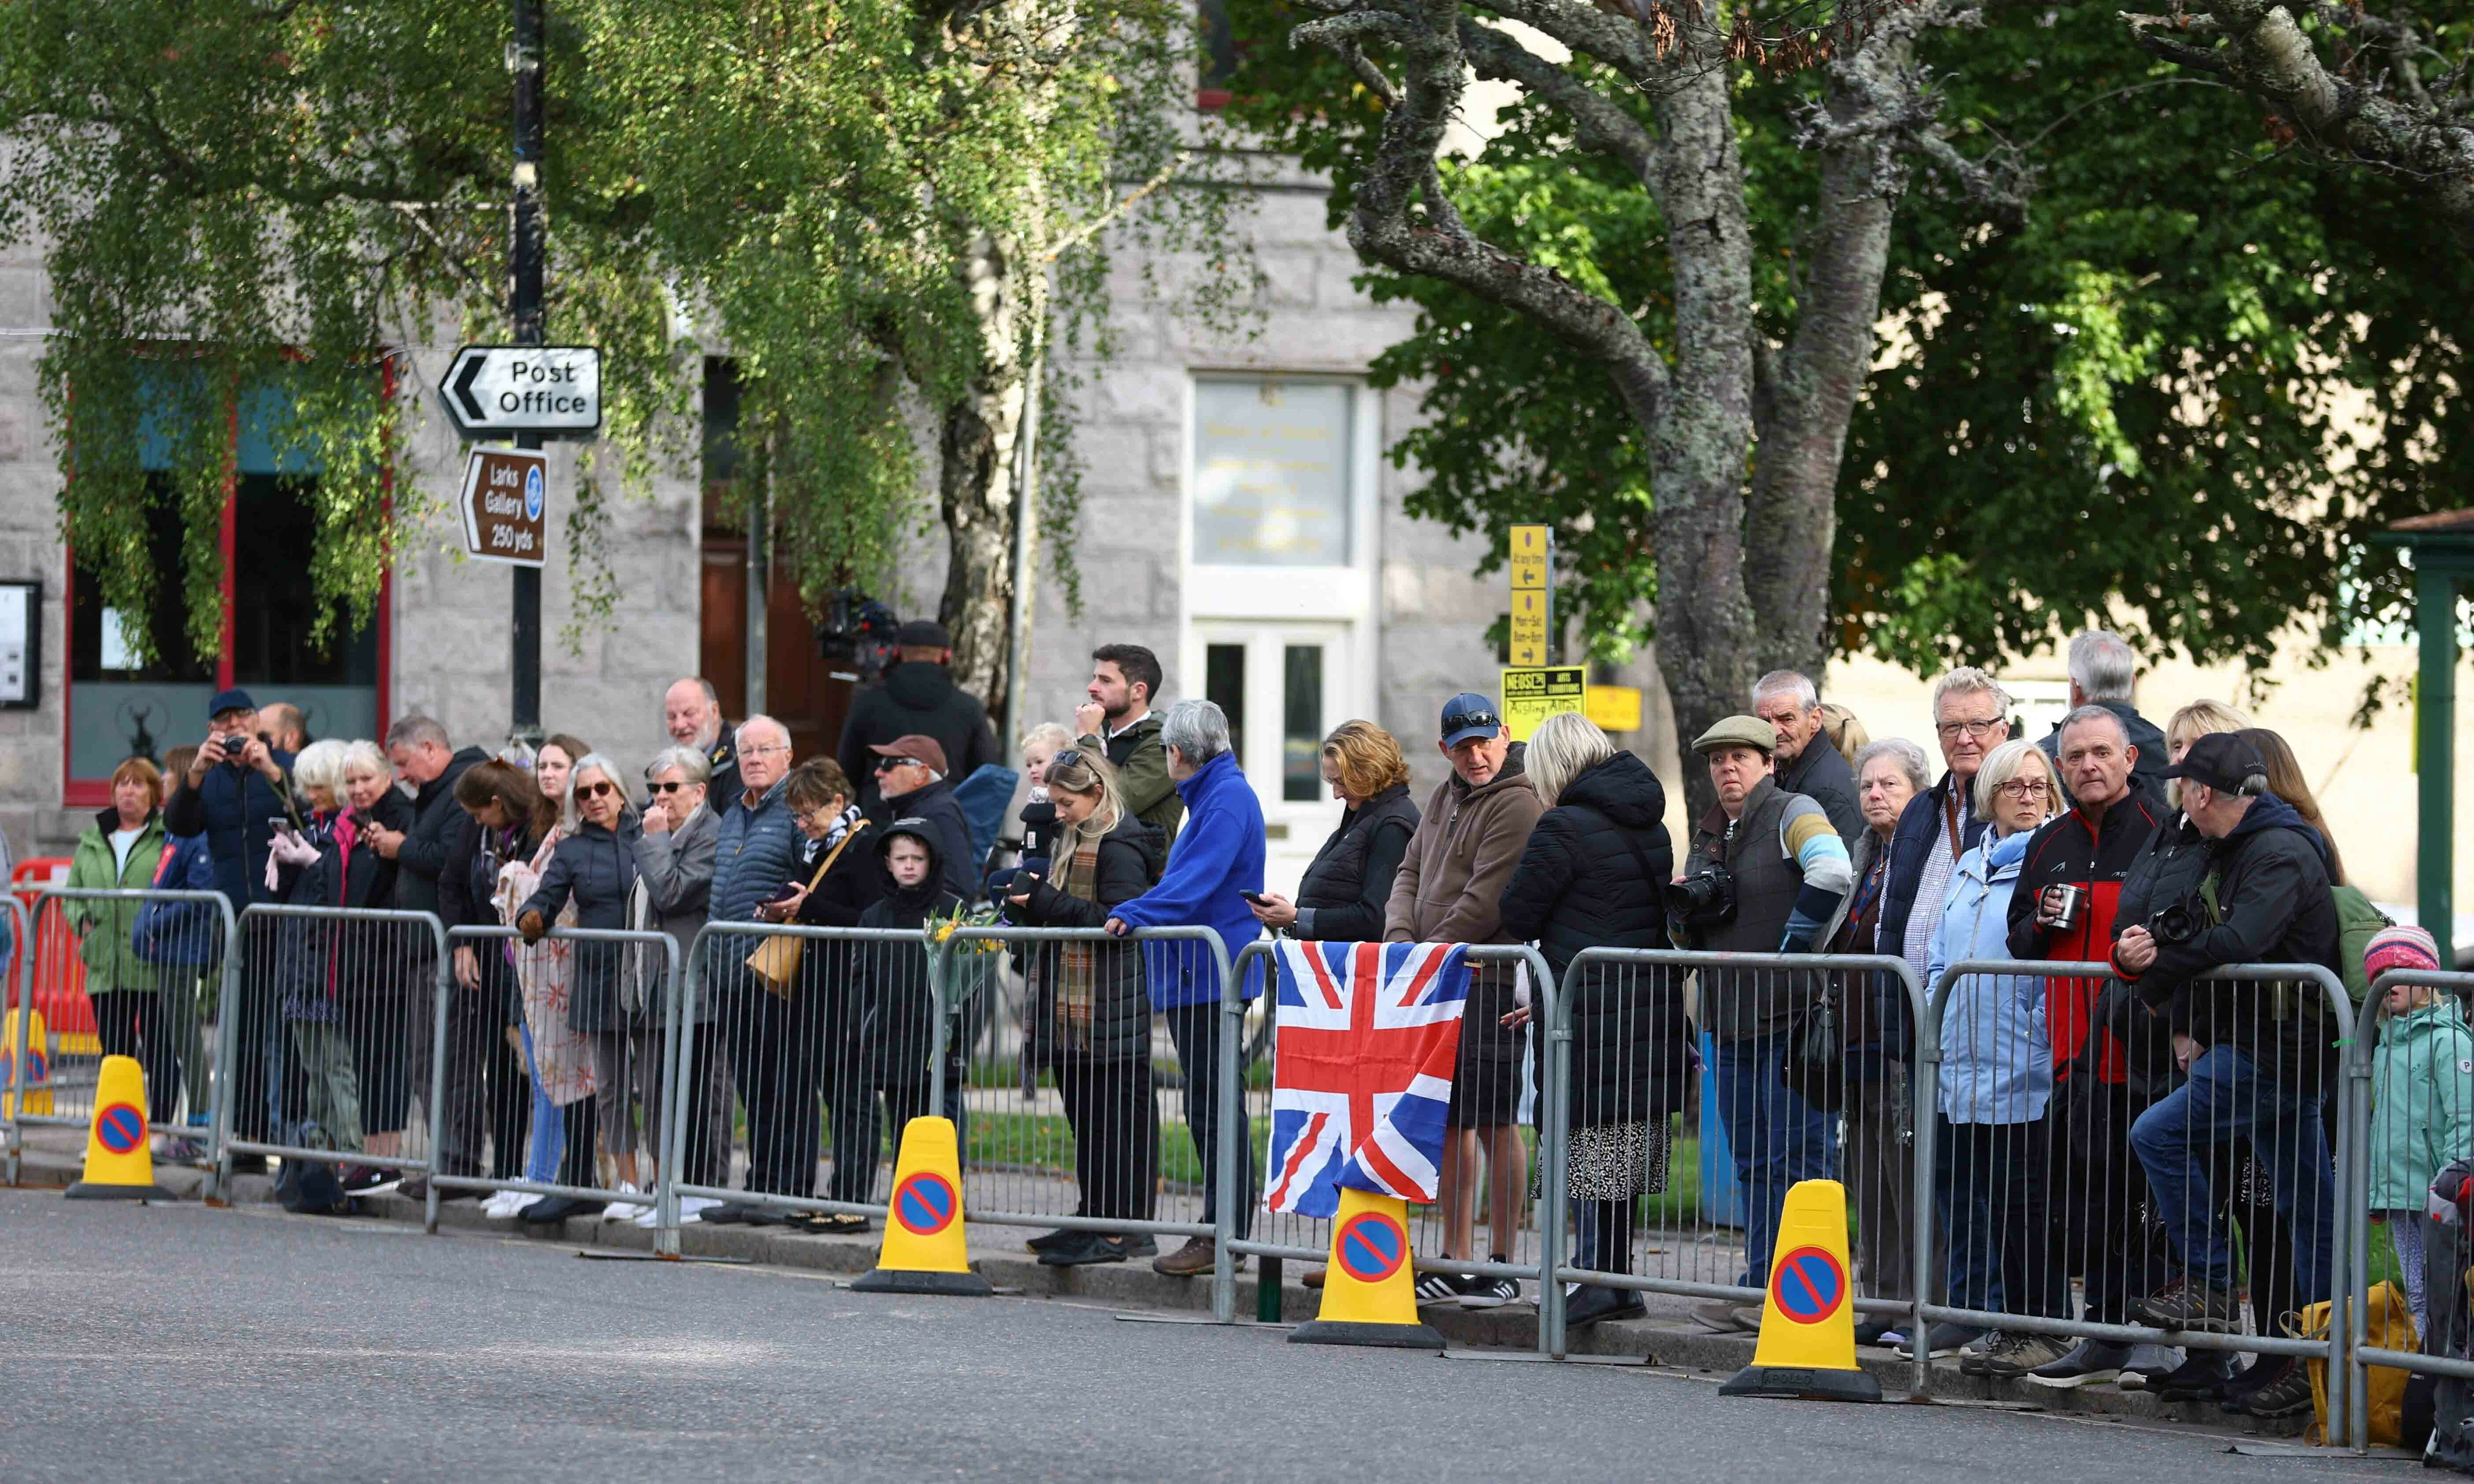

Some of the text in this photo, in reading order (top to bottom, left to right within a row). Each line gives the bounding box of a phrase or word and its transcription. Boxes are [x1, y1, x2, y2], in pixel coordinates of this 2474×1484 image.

[513, 361, 575, 382] Post
[500, 391, 586, 413] Office
[490, 463, 519, 488] Larks
[485, 490, 523, 520] Gallery
[492, 523, 533, 553] 250 yds
[1506, 674, 1531, 690] NEOS
[2464, 1061, 2470, 1070] P
